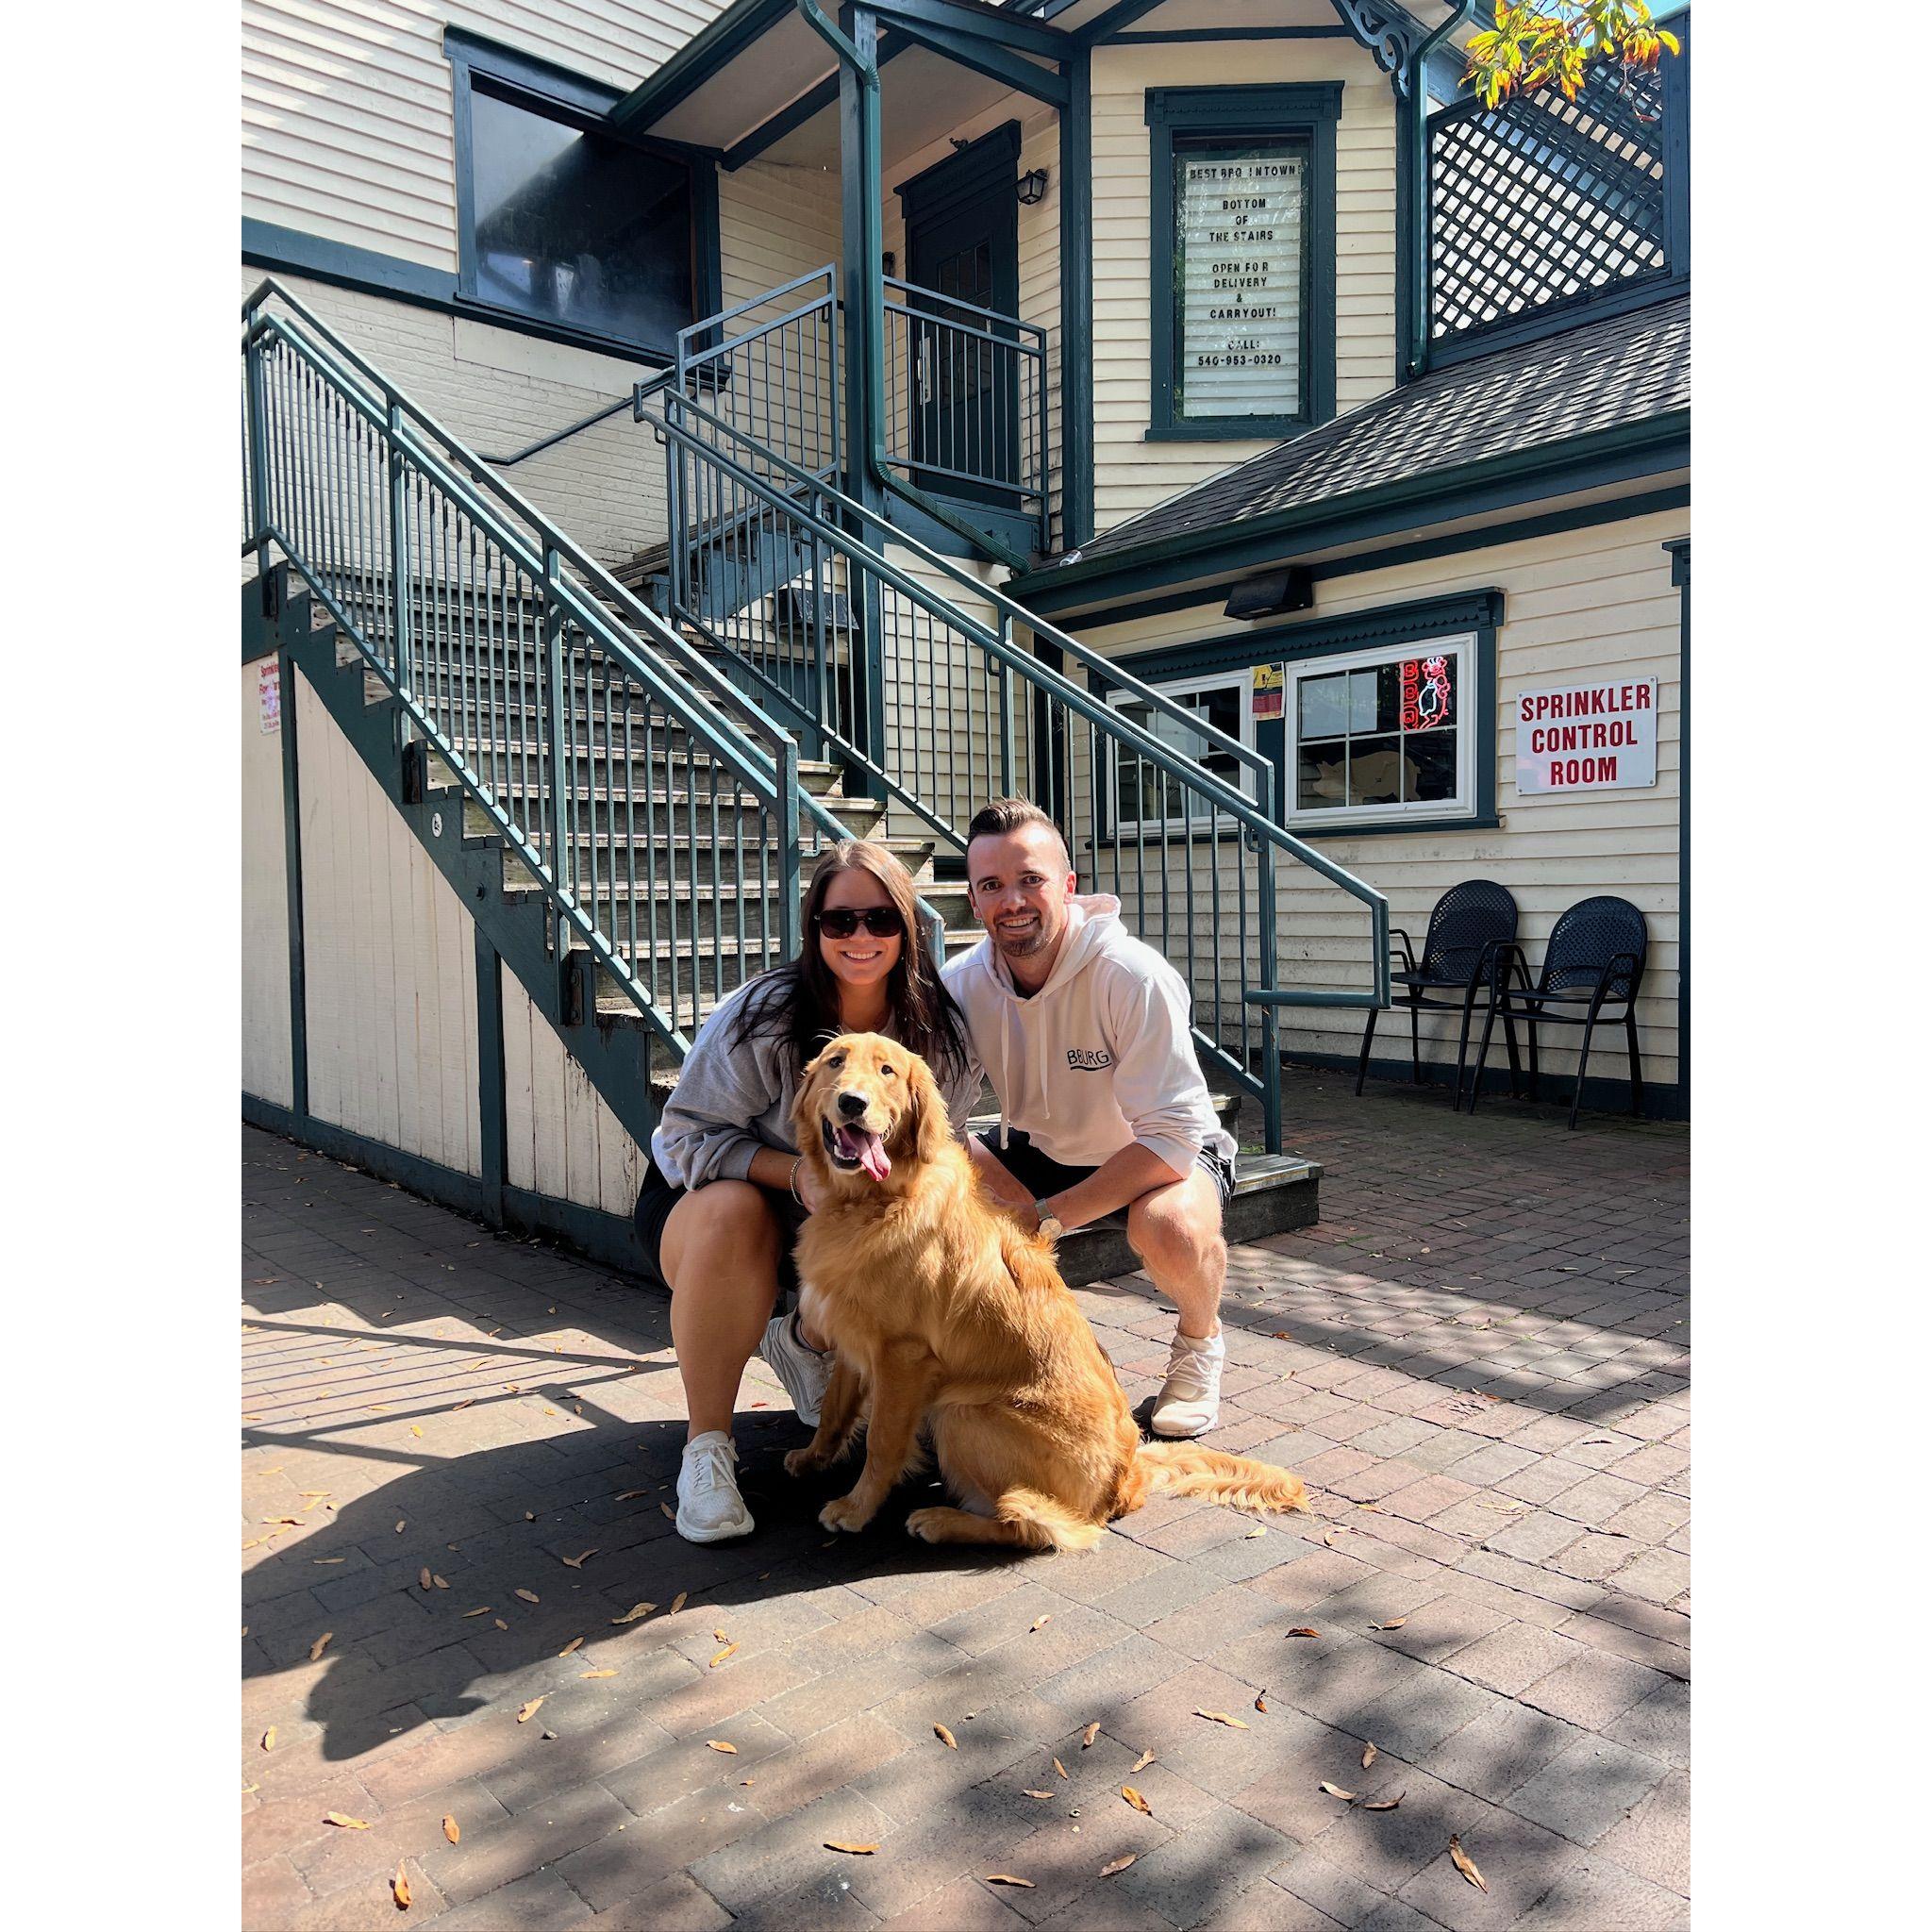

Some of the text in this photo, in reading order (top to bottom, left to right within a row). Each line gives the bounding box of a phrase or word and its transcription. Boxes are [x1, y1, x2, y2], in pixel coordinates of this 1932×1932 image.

[1190, 168, 1217, 179] BEST
[1223, 199, 1266, 209] BOTTOM
[1236, 215, 1248, 225] OF
[1209, 230, 1274, 242] THE STAIRS
[1212, 261, 1269, 274] OPEN FOR
[1214, 277, 1267, 289] DELIVERY
[1236, 292, 1242, 303] &
[1209, 308, 1276, 319] CARRYOUT!
[1198, 354, 1281, 366] 540-953-0320
[1400, 659, 1419, 731] BBQ
[1521, 684, 1651, 722] SPRINKLER
[1532, 720, 1638, 754] CONTROL
[1550, 756, 1617, 786] ROOM
[1067, 1049, 1109, 1065] BBURG
